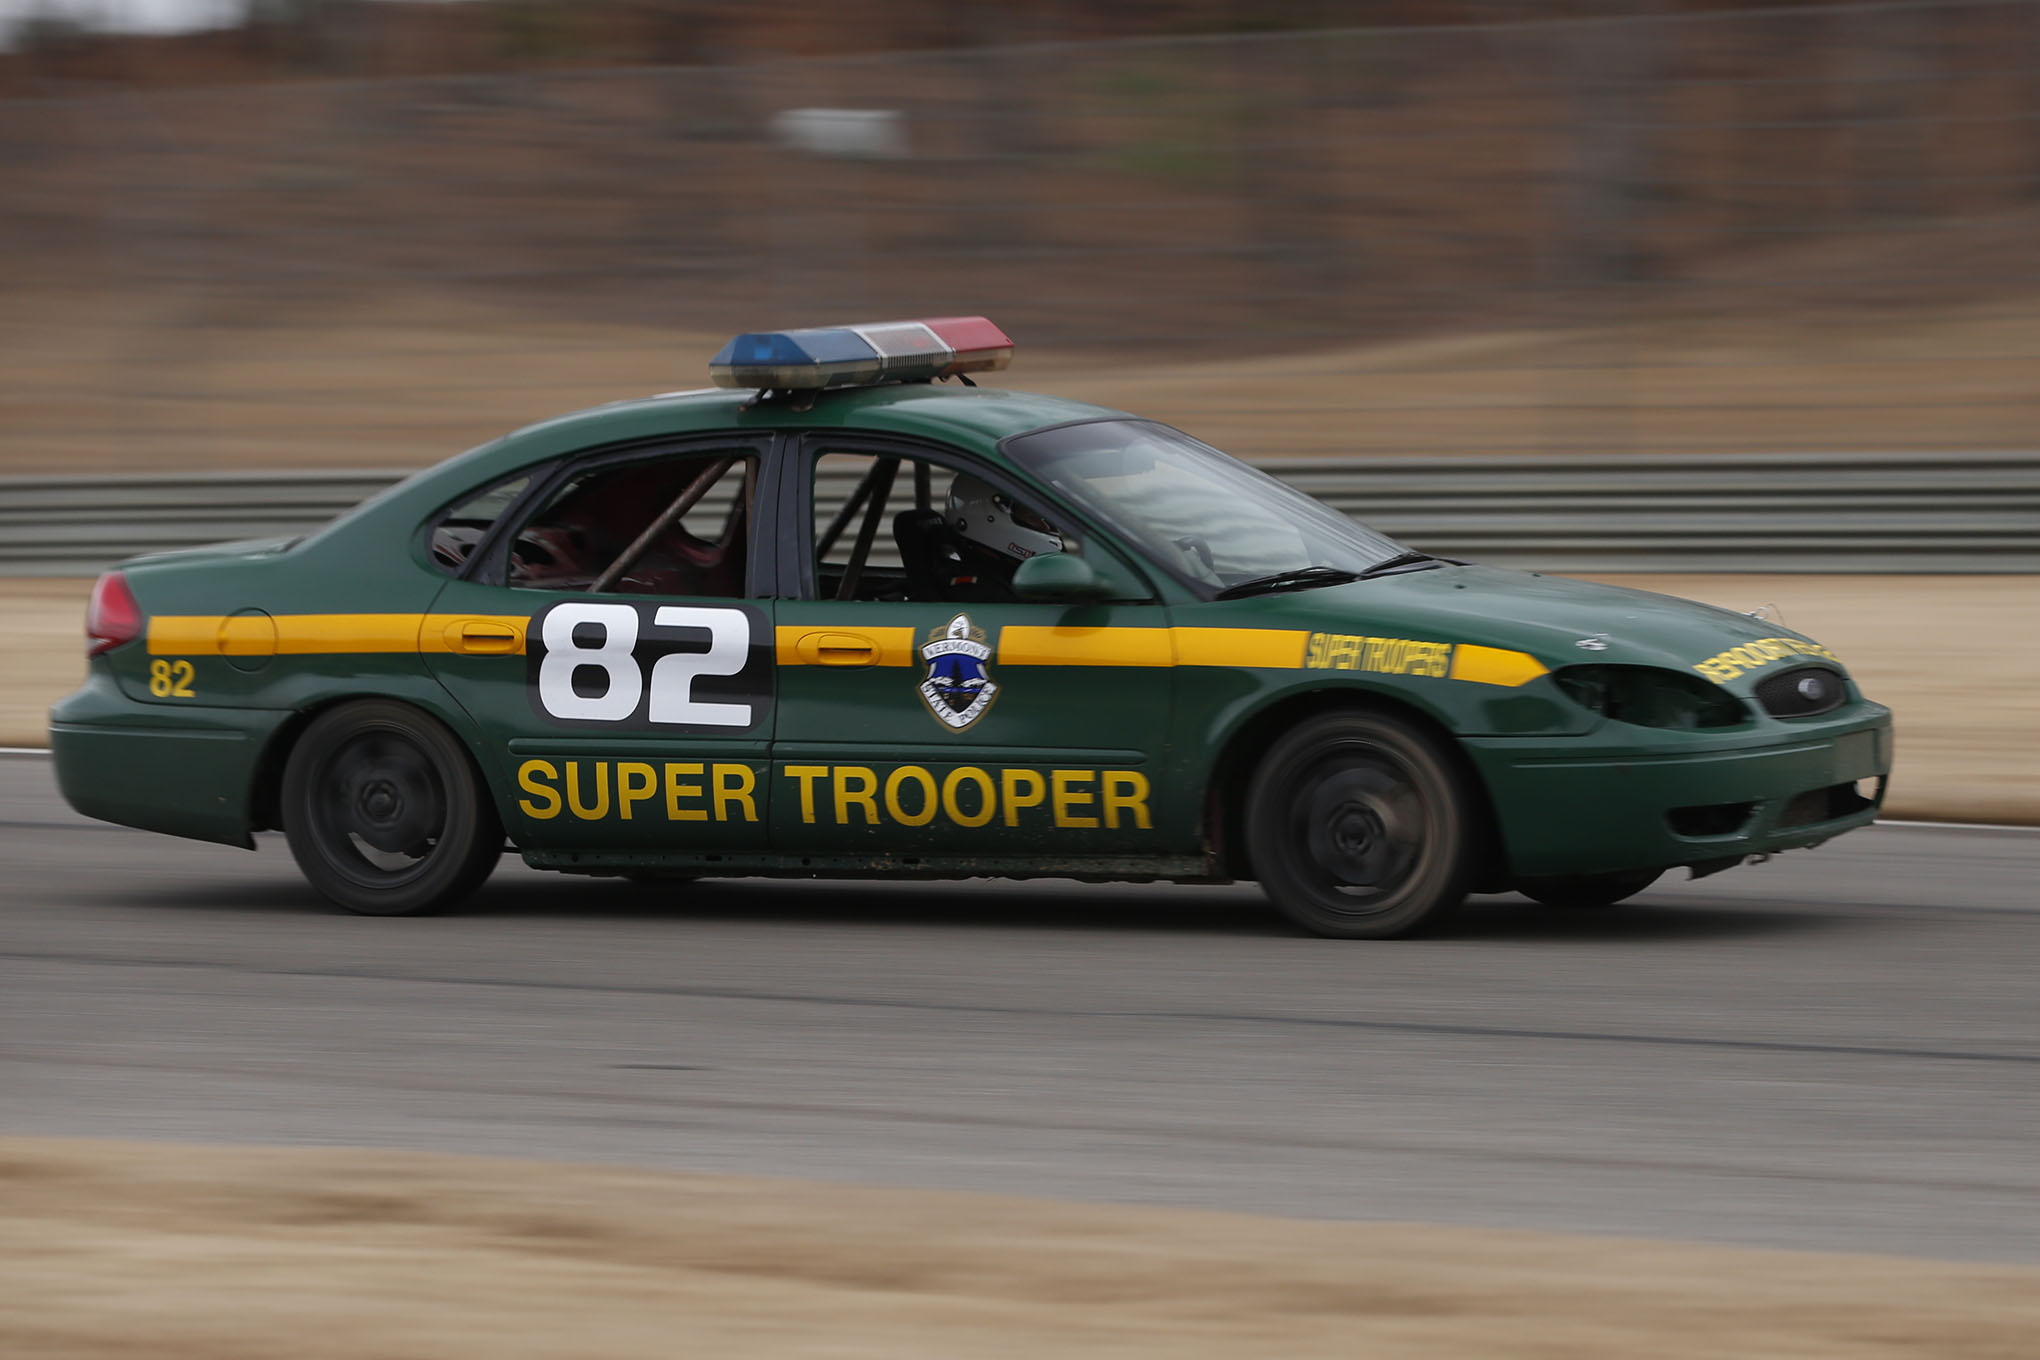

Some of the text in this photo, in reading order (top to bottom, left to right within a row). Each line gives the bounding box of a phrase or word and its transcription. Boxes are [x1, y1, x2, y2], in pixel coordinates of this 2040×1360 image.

[538, 602, 751, 727] 82
[925, 641, 989, 660] VERMONT
[1307, 632, 1451, 678] SUPER TROOPERS
[150, 659, 196, 698] 82
[517, 759, 1154, 829] SUPER TROOPER
